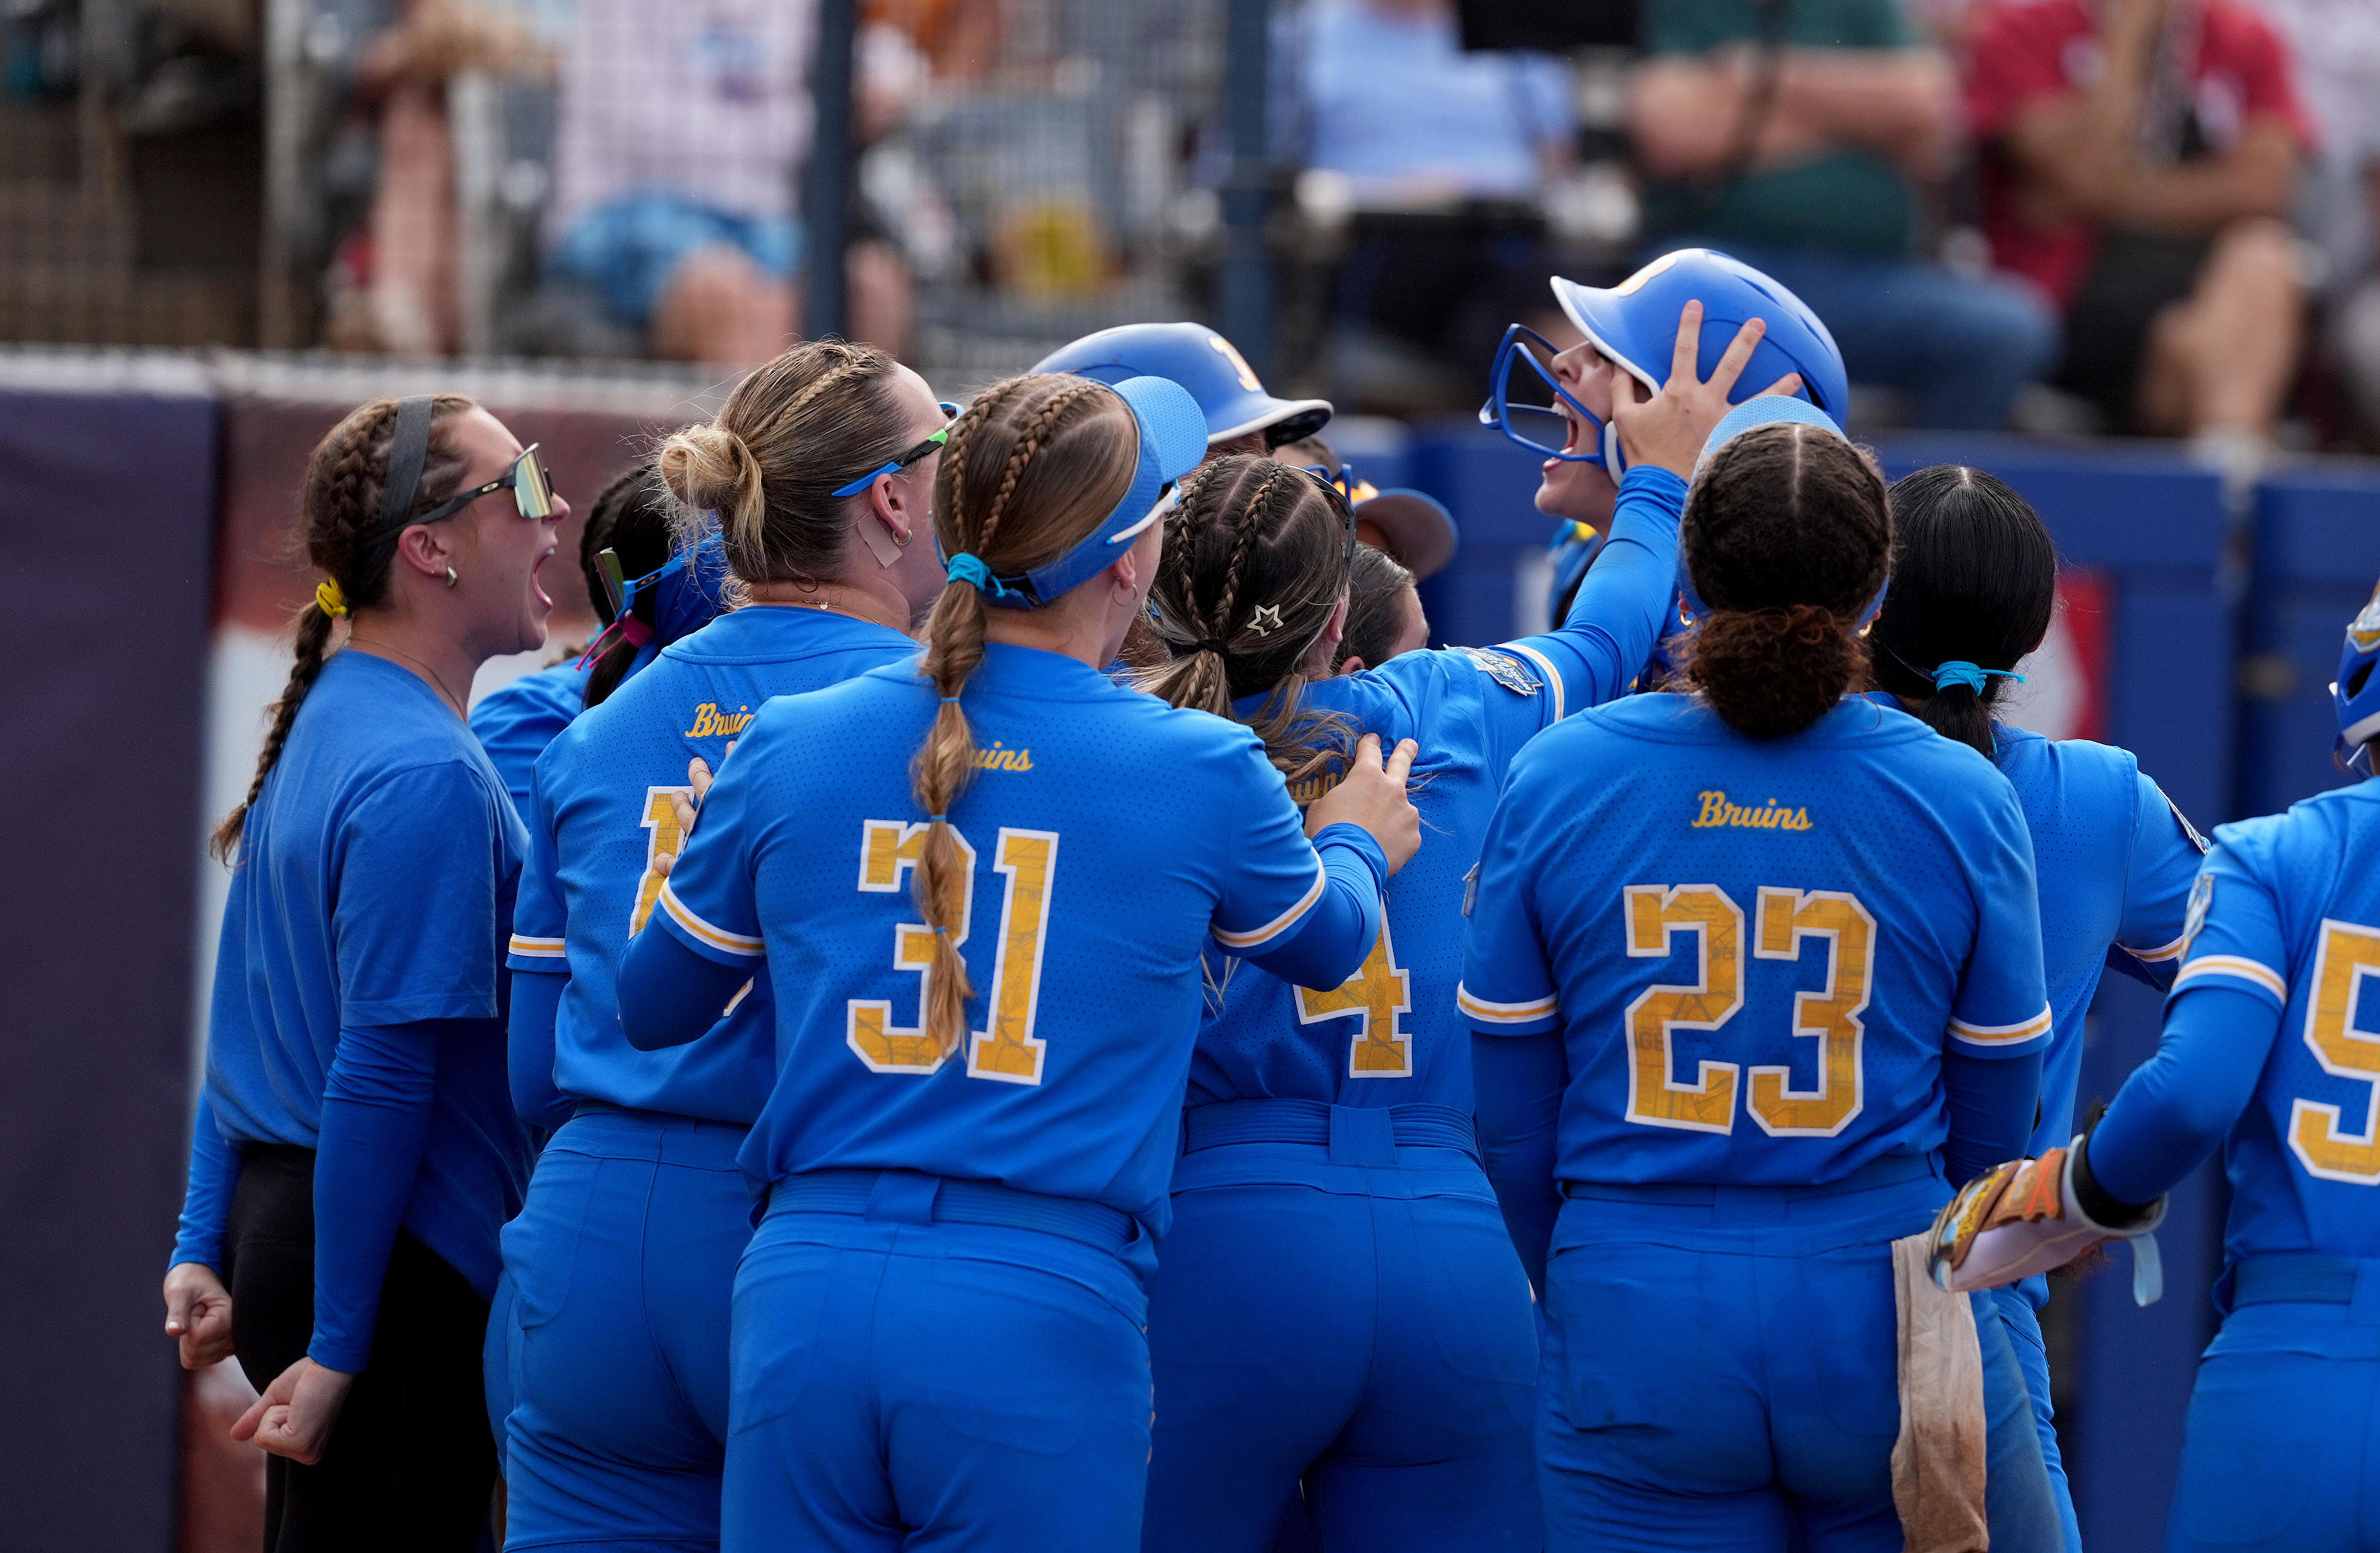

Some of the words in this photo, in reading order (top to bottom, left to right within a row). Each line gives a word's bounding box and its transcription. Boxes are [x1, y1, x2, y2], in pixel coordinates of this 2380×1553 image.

[967, 740, 1034, 772] uins
[1690, 790, 1814, 831] Bruins
[847, 819, 1059, 1086] 31
[1623, 884, 1877, 1137] 23
